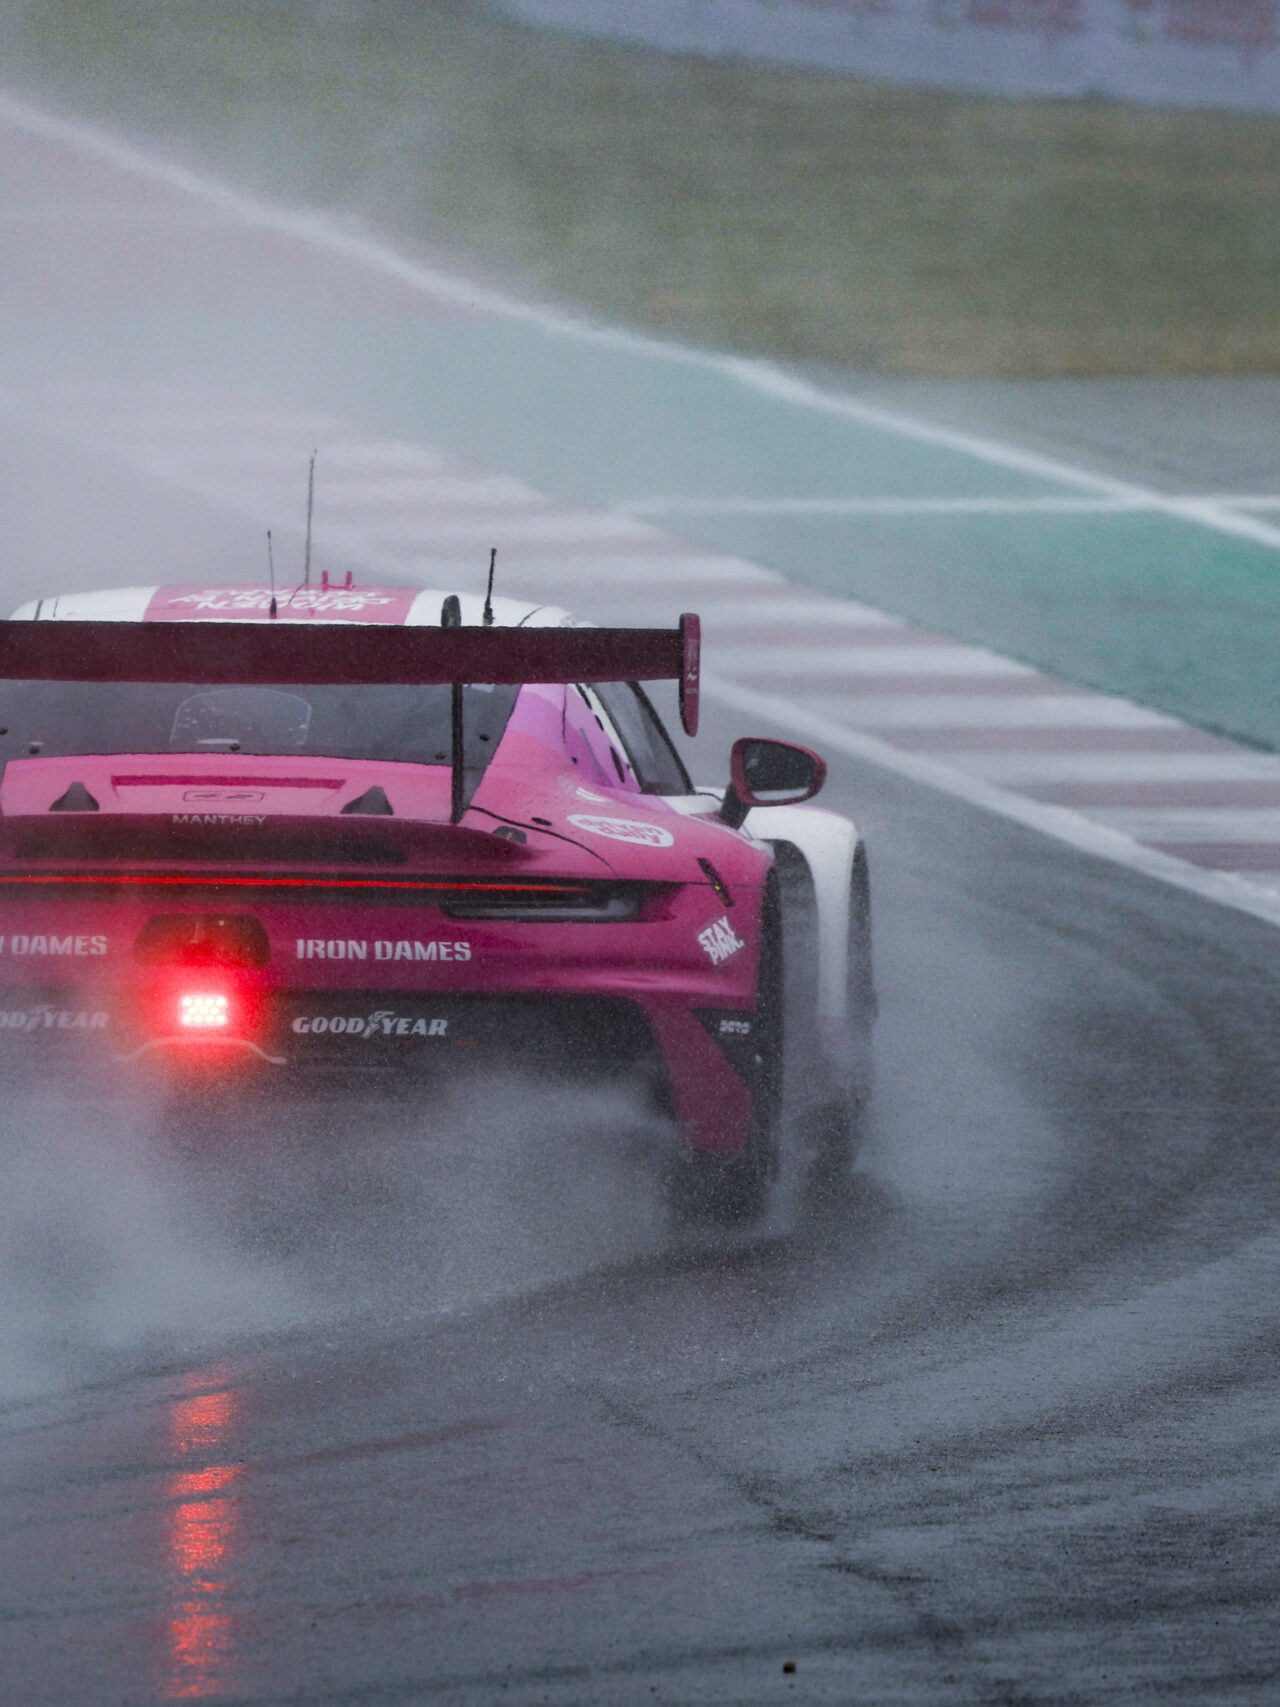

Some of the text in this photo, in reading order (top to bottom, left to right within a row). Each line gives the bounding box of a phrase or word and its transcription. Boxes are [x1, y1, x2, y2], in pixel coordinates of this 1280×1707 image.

[173, 814, 268, 826] MANTHEY
[698, 915, 734, 951] STAY
[11, 935, 108, 955] DAMES
[296, 939, 472, 961] IRON DAMES
